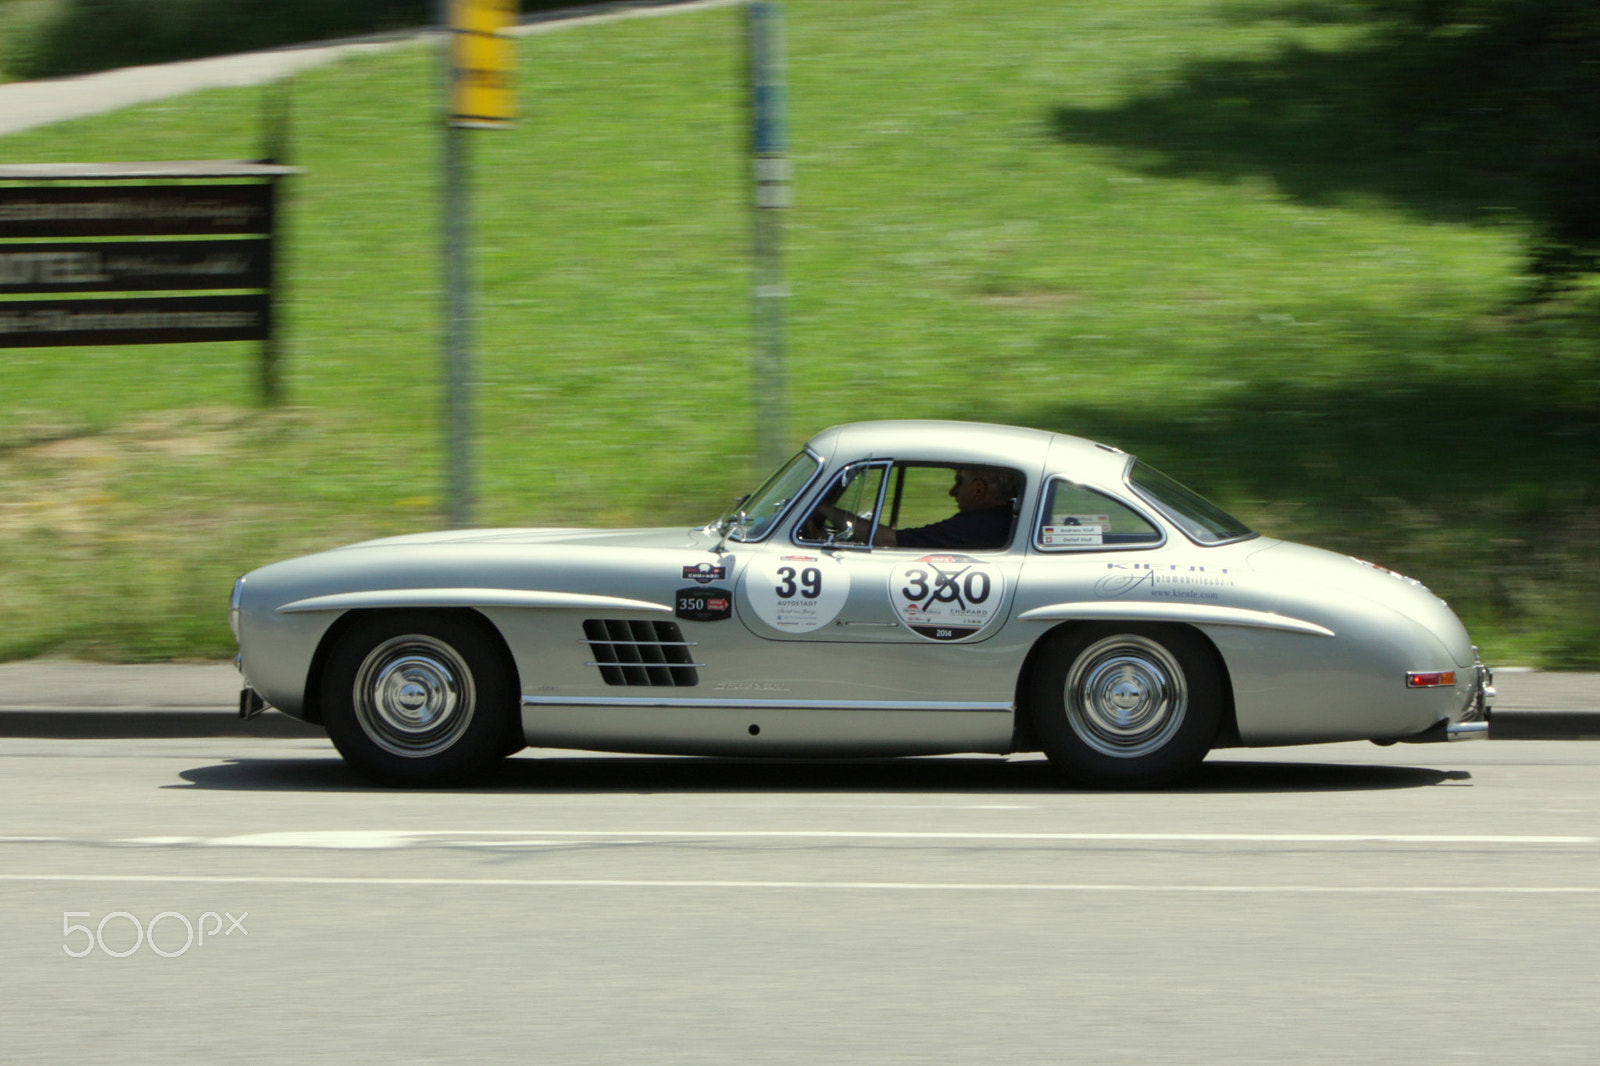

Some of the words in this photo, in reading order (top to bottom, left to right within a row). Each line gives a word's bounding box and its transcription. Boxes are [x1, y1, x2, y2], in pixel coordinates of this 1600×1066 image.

[775, 566, 822, 599] 39
[1151, 589, 1218, 599] www.kienle.com
[679, 598, 704, 611] 350
[950, 608, 988, 616] CHOPARD
[936, 629, 952, 638] 2014
